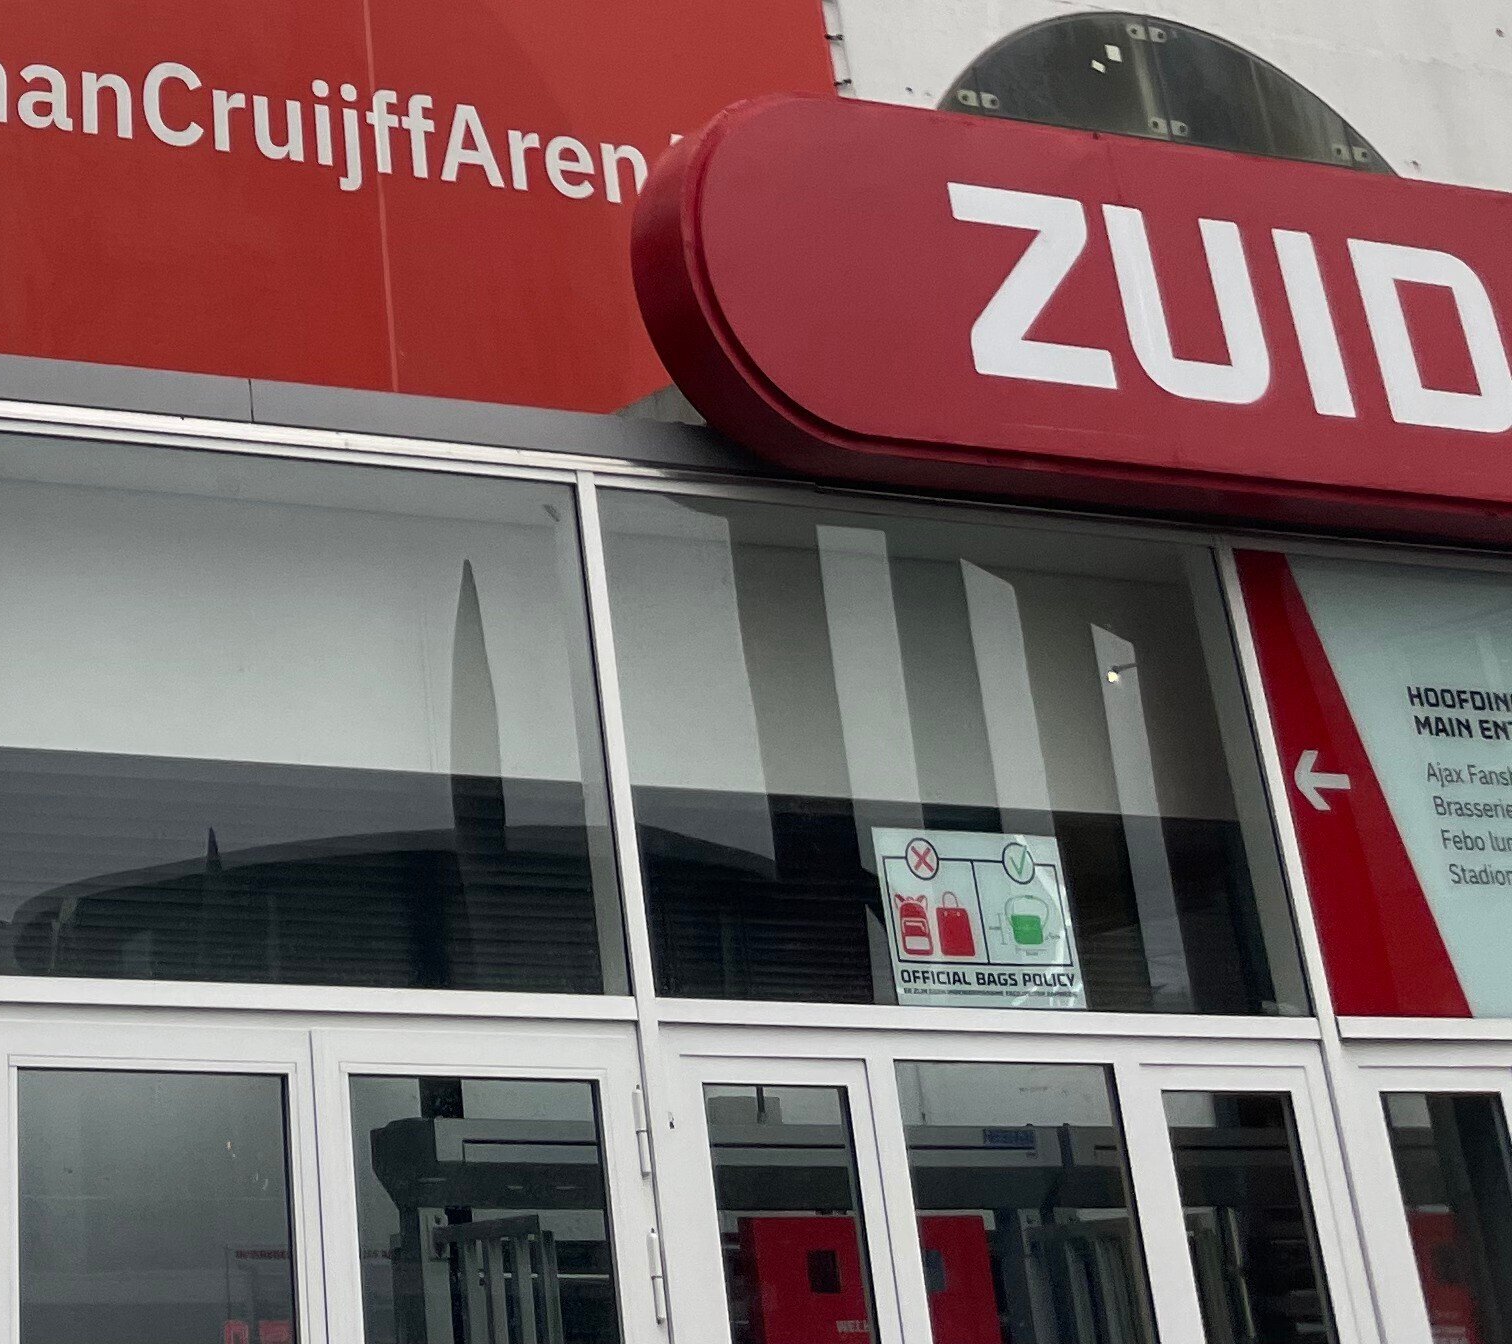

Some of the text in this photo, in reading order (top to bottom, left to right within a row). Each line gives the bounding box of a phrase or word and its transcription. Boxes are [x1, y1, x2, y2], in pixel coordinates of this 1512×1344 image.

[946, 181, 1512, 434] ZUID
[1406, 685, 1512, 714] HOOFDIN
[1413, 714, 1474, 739] MAIN
[1426, 761, 1465, 787] Ajax
[1440, 828, 1486, 851] Febo
[901, 969, 1075, 988] OFFICIAL BAGS POLICY
